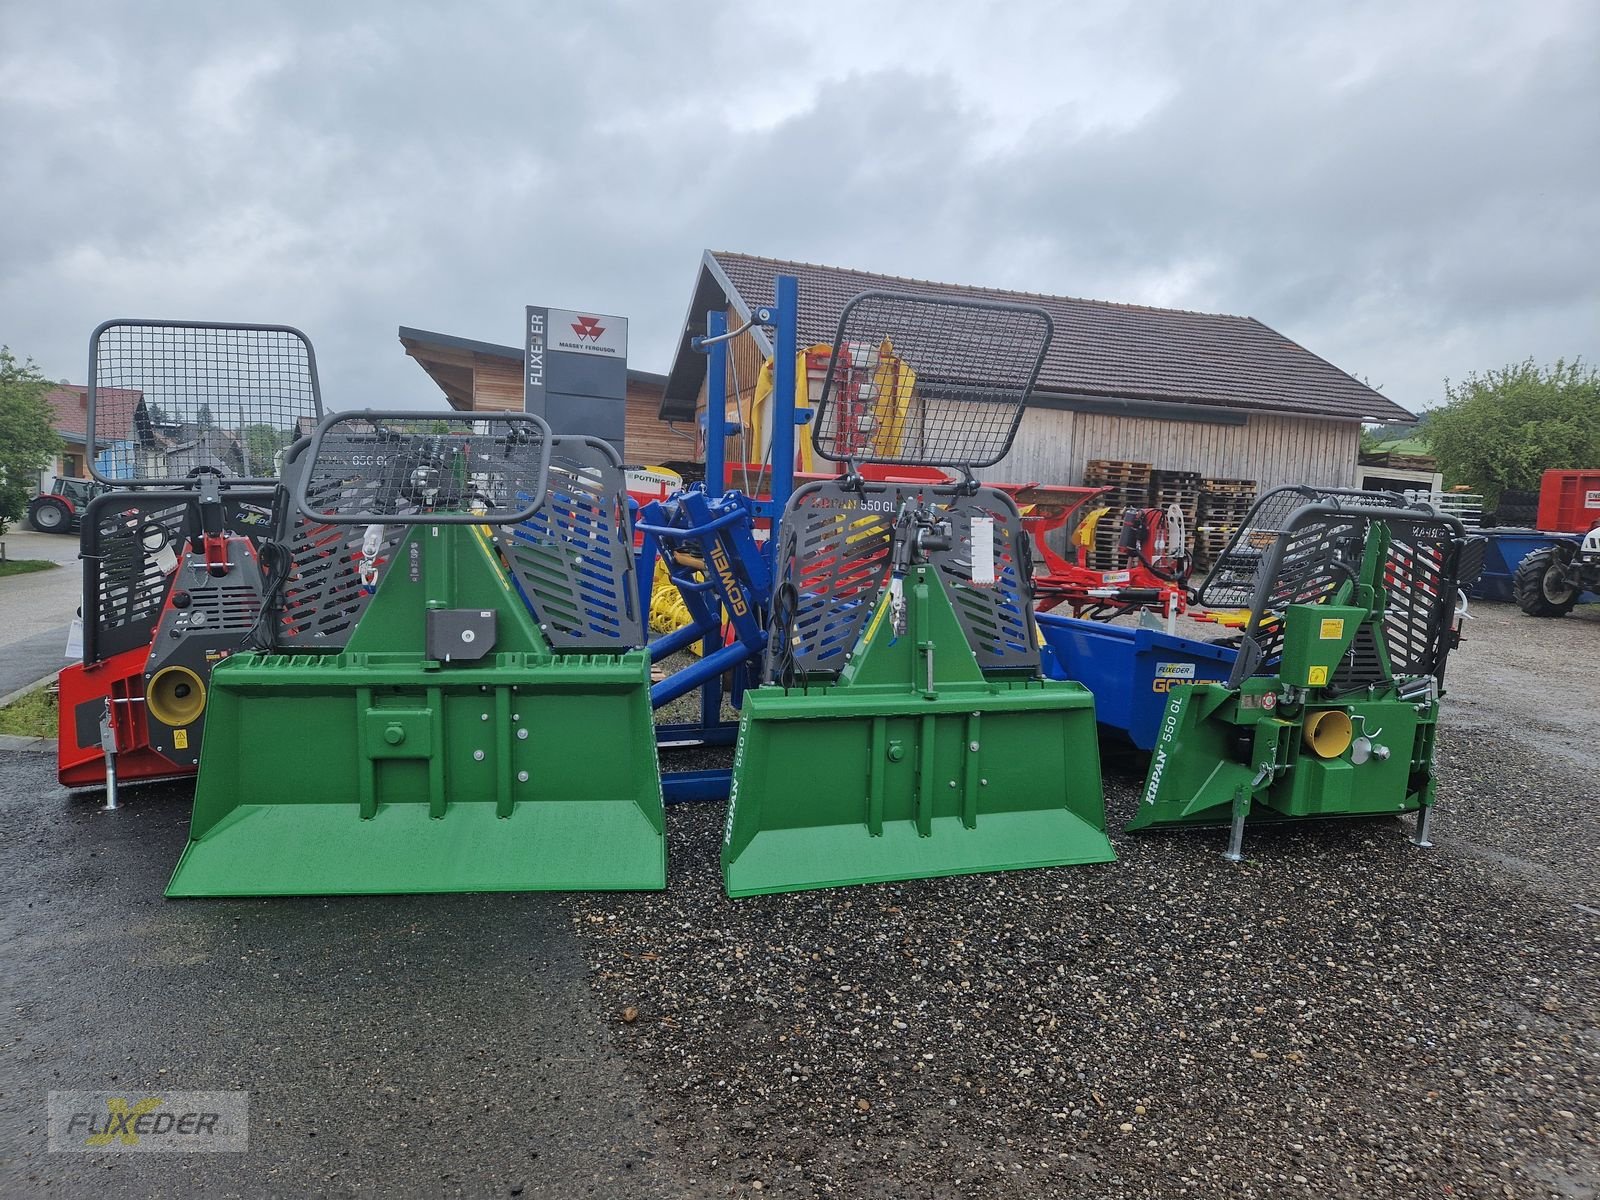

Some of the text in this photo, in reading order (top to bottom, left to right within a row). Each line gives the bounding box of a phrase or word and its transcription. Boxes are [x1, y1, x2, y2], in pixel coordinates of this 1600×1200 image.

[559, 342, 583, 350] MASSEY
[860, 500, 880, 511] 550
[883, 501, 896, 513] GL
[1158, 666, 1190, 674] FLIXEDER
[740, 713, 749, 732] GL
[1163, 716, 1176, 742] 550
[1170, 698, 1182, 714] GL
[736, 736, 745, 768] 550
